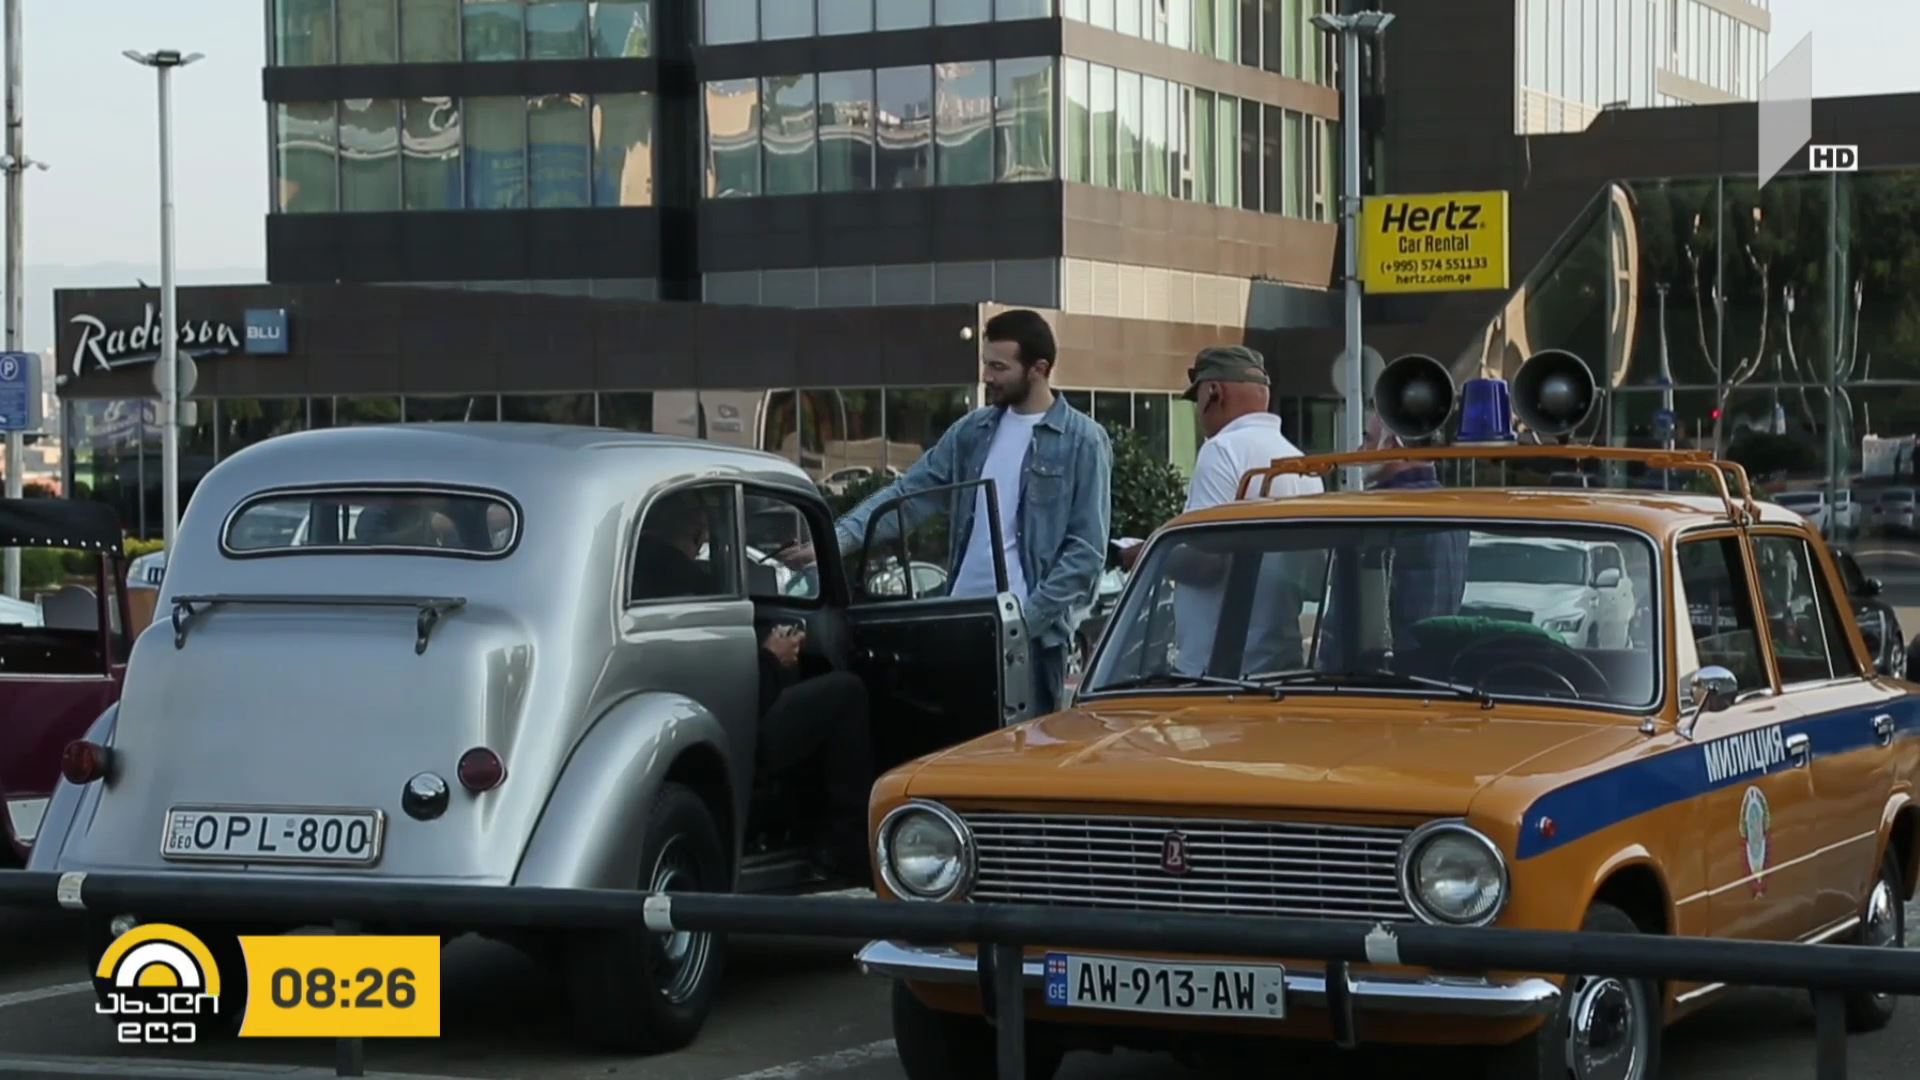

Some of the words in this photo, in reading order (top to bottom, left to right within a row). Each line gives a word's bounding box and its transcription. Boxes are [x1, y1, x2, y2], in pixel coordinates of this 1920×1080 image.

[1381, 201, 1482, 233] Hertz
[1399, 235, 1421, 254] Car
[1425, 233, 1469, 252] Rental
[1380, 259, 1418, 274] (+995)
[1421, 258, 1442, 271] 574
[1446, 257, 1488, 270] 551133
[1396, 273, 1472, 285] hertz.com.ge
[70, 302, 240, 376] Radison
[247, 326, 280, 340] BLU
[1703, 724, 1786, 783] МИЛИЦИЯ
[169, 836, 192, 849] GEO
[194, 815, 368, 854] OPL-800
[1049, 983, 1067, 1000] GE
[1077, 963, 1255, 1011] AW-913-AW
